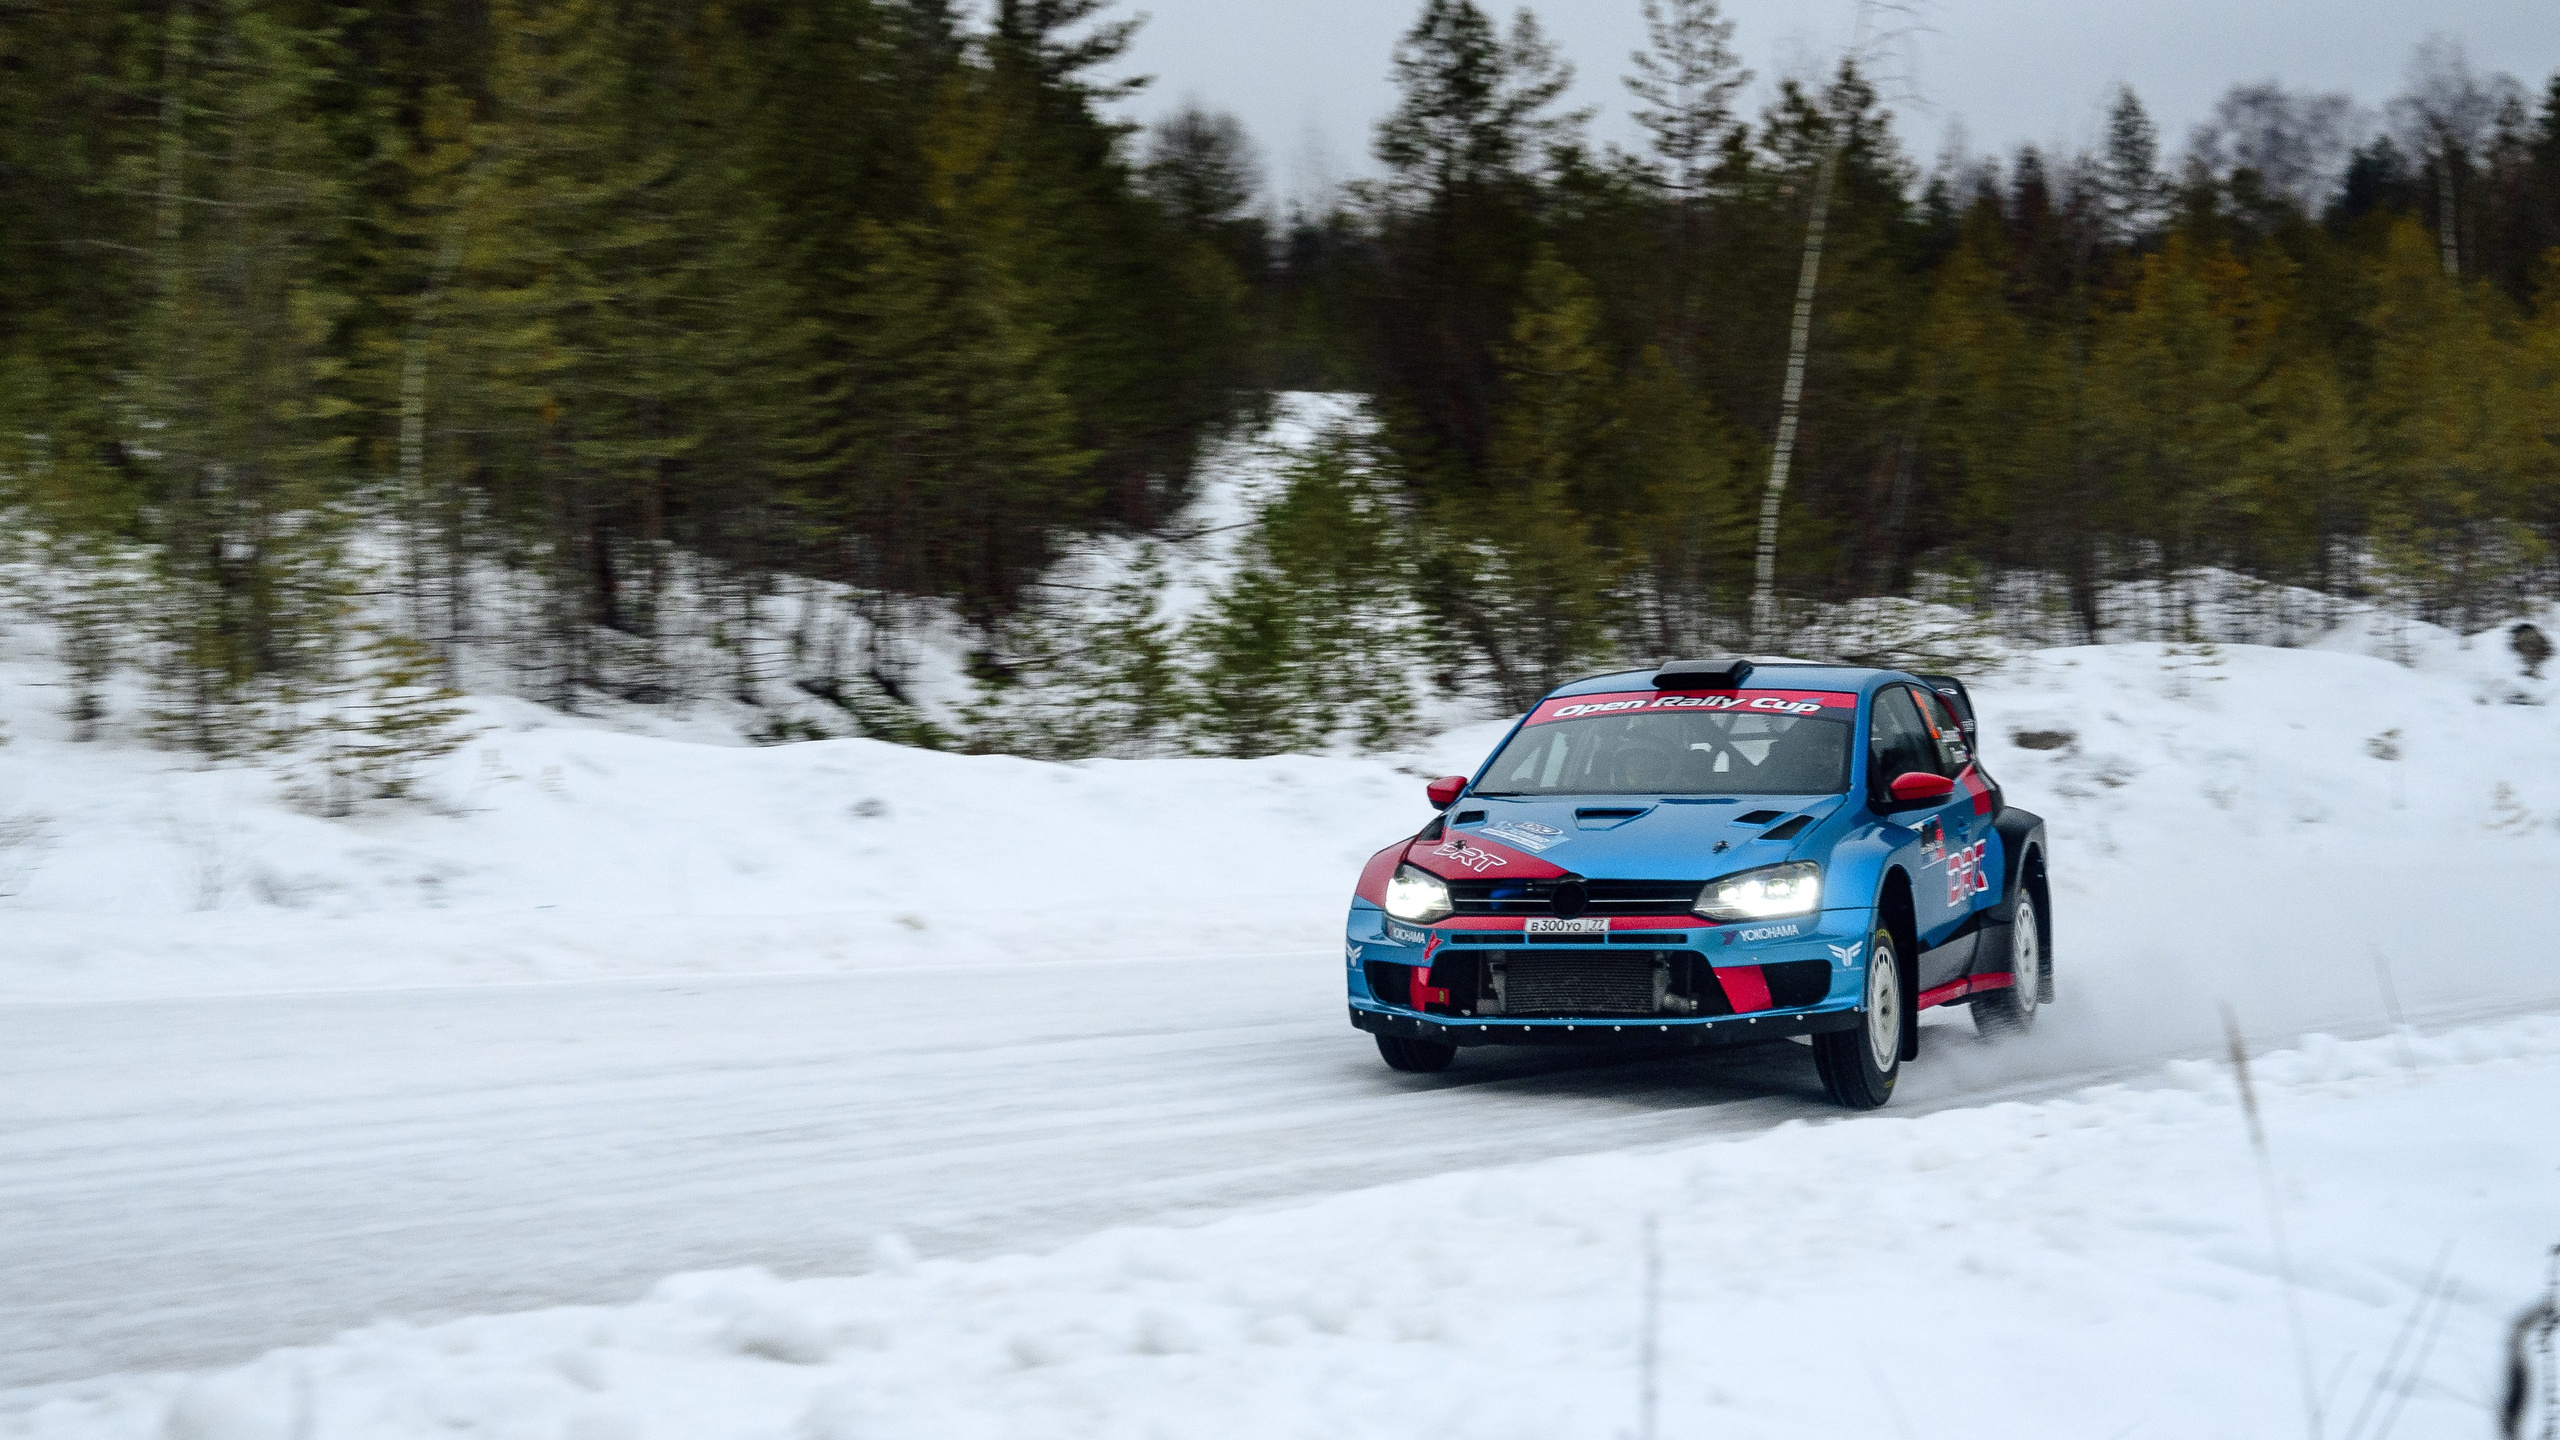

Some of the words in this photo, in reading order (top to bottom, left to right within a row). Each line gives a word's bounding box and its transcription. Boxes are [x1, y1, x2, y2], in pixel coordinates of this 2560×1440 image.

[1552, 699, 1647, 717] Open
[1650, 695, 1747, 709] Rally
[1750, 697, 1822, 713] Cup
[1433, 842, 1507, 873] DRT
[1591, 919, 1605, 928] 77
[1739, 924, 1799, 942] YOKOHAMA
